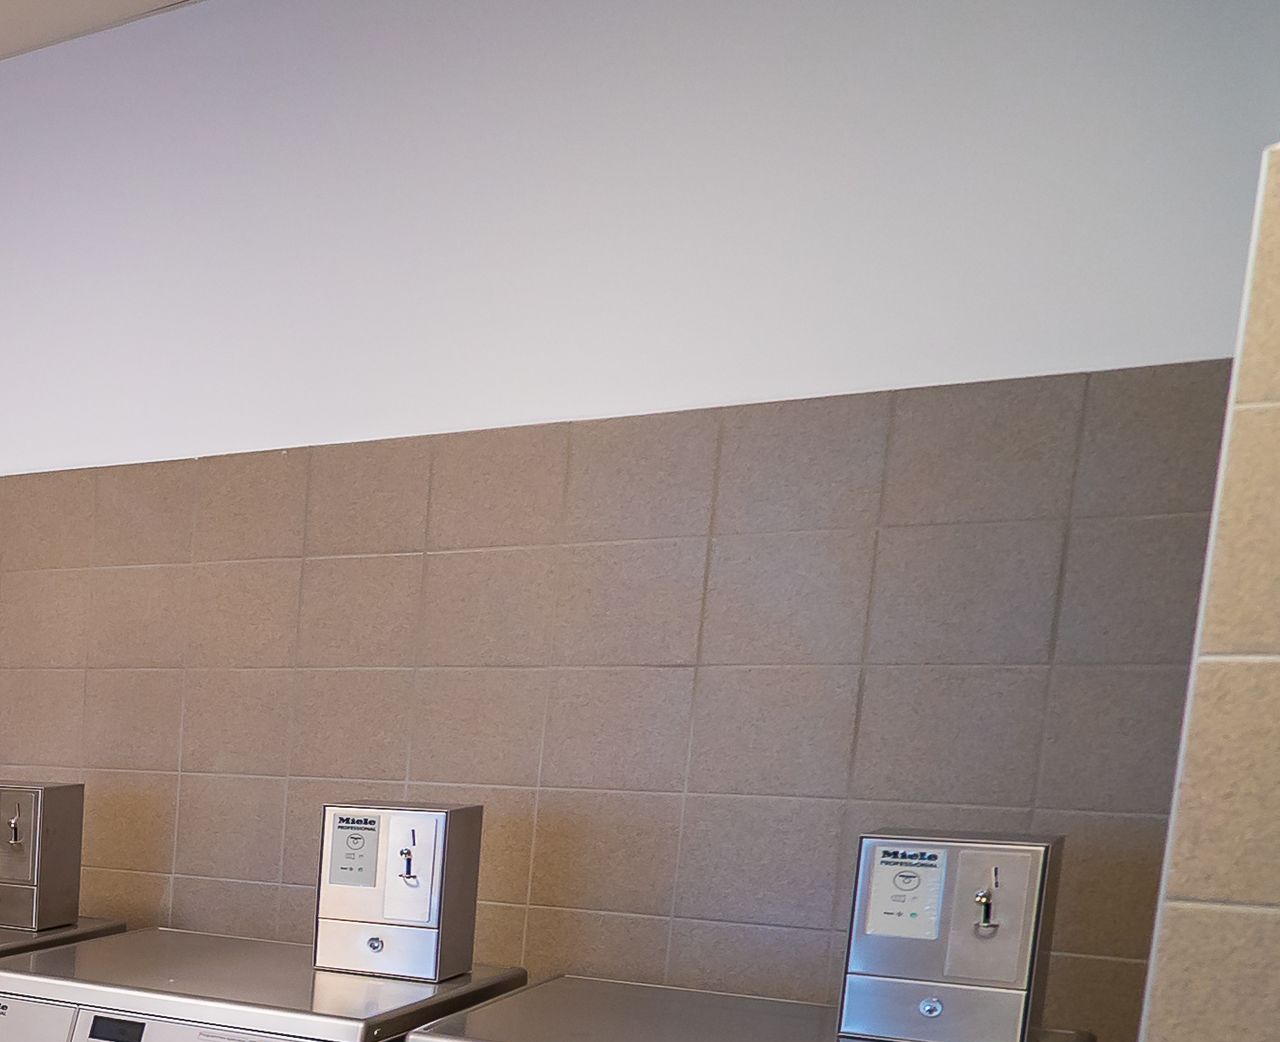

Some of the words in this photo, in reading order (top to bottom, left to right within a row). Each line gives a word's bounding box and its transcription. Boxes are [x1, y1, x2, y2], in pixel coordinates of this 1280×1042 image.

[338, 816, 377, 826] Miele
[881, 850, 939, 862] Miele
[880, 860, 938, 868] PROFESSIONAL
